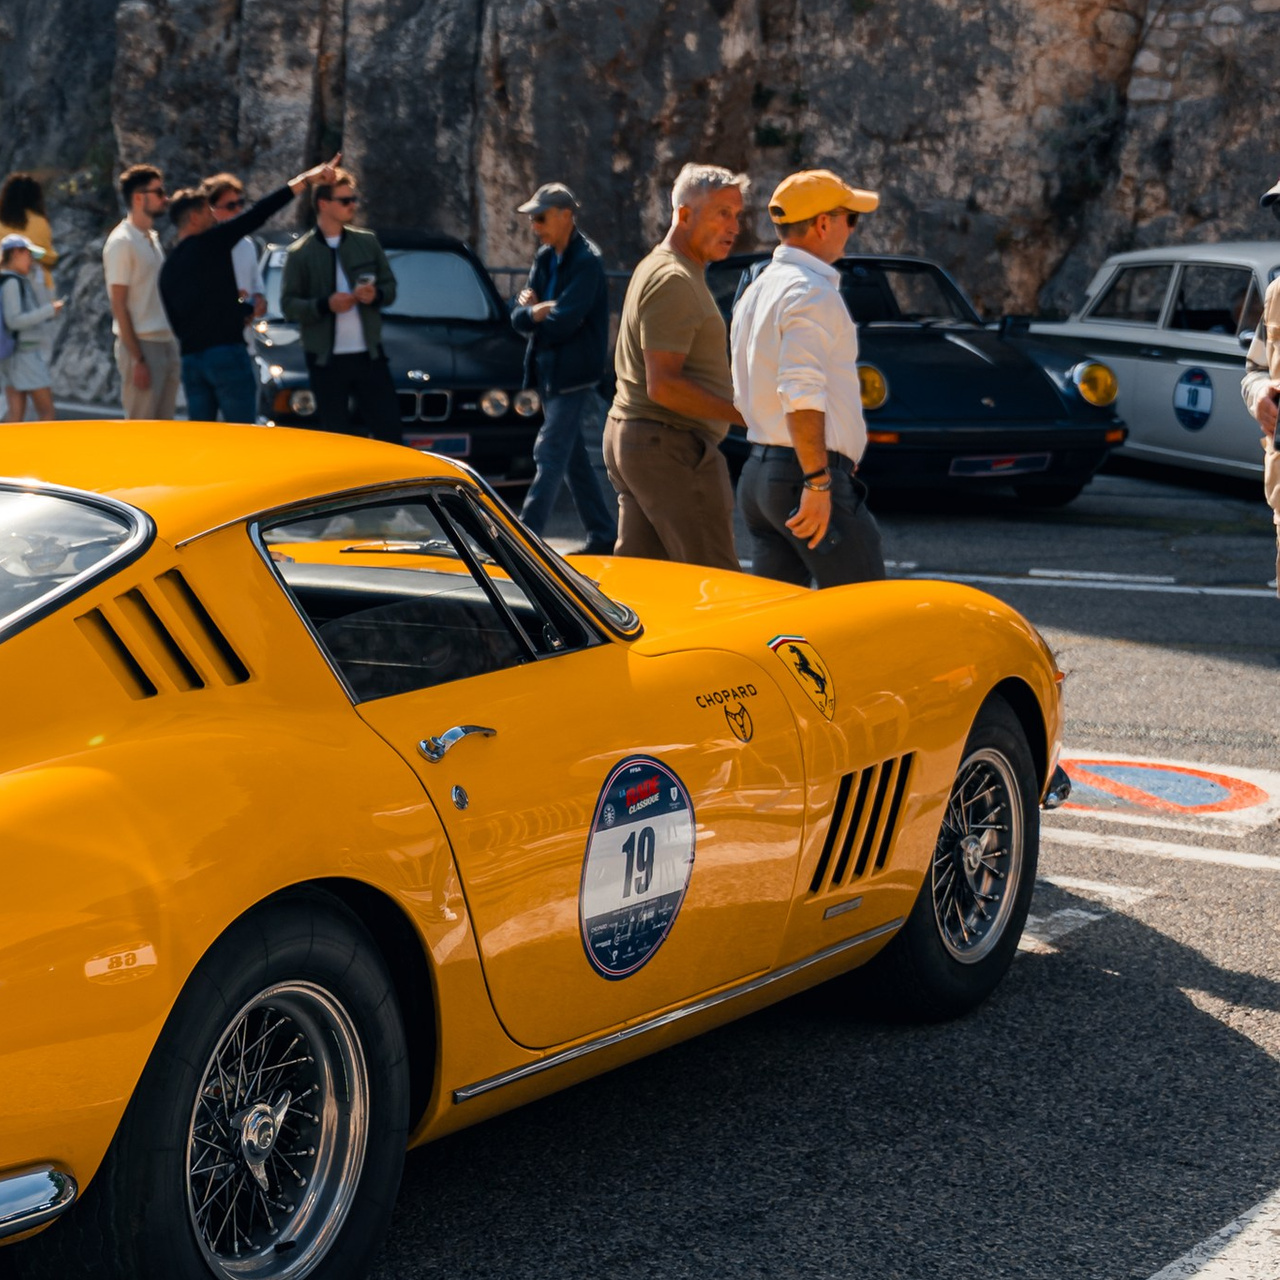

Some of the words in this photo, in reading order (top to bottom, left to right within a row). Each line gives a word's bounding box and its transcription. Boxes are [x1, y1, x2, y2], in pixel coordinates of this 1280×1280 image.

[1187, 387, 1199, 408] 10
[696, 683, 758, 708] CHOPARD
[628, 792, 660, 815] CLASSIQUE
[622, 826, 656, 898] 19
